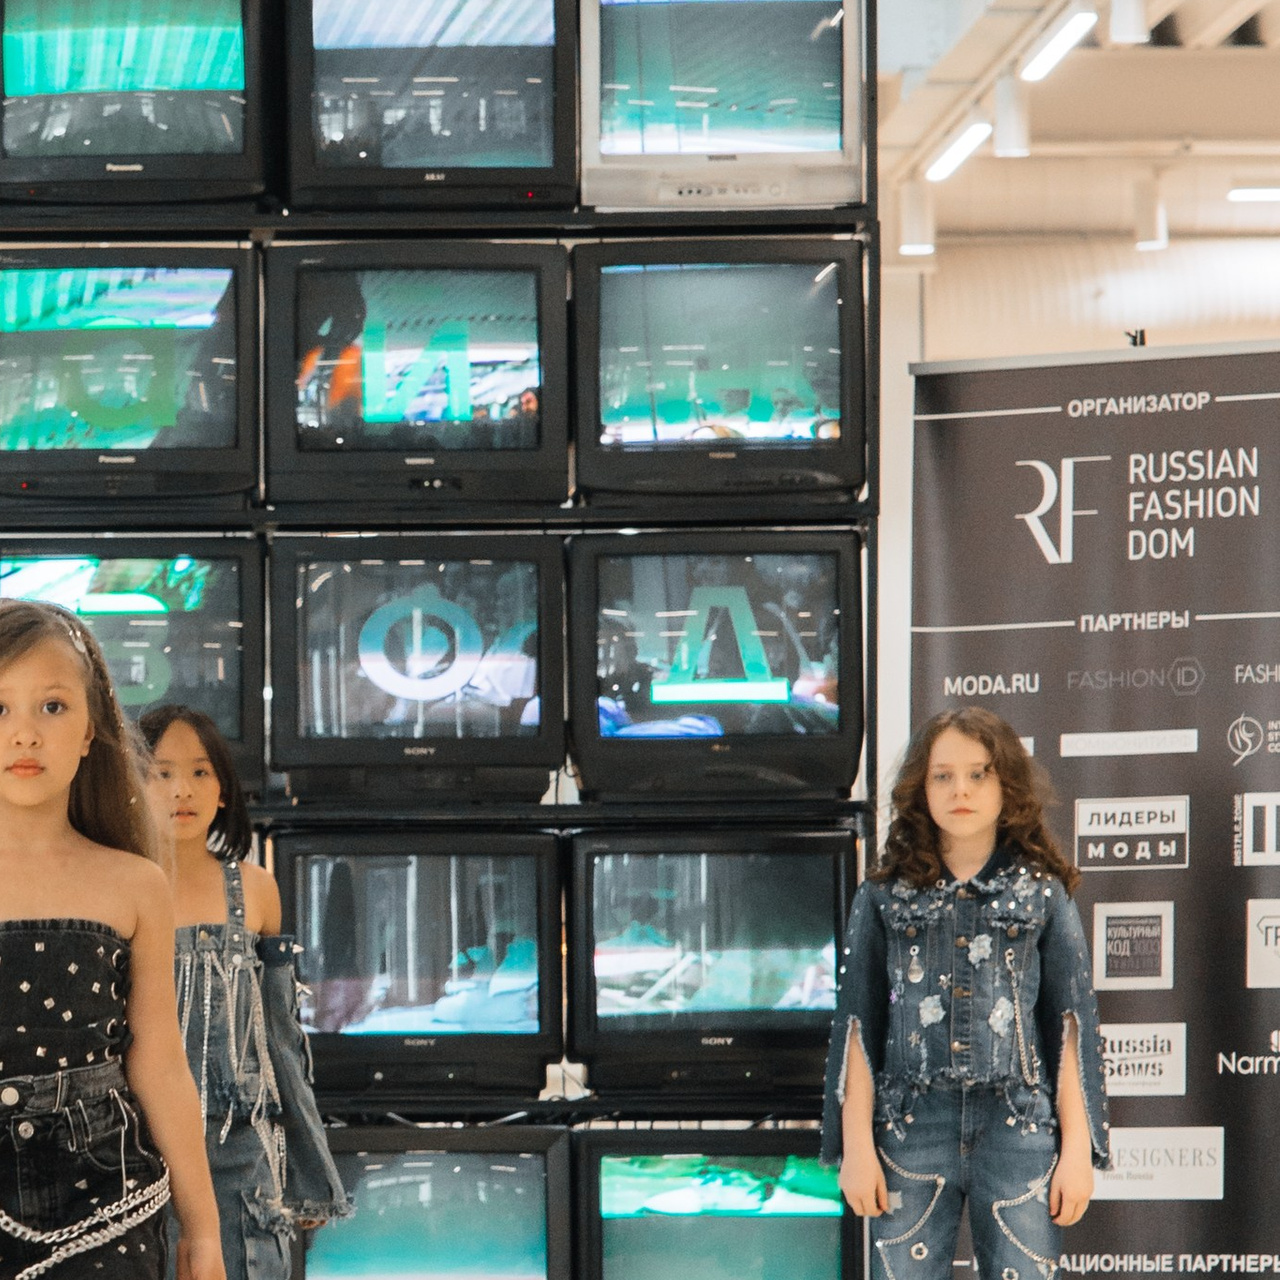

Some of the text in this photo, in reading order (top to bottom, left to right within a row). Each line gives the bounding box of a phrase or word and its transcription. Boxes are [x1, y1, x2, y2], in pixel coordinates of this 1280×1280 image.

[1067, 391, 1211, 418] ОРГАНИЗАТОР
[1128, 446, 1258, 484] RUSSIAN
[1128, 485, 1260, 522] FASHION
[1127, 527, 1195, 561] DOM
[1080, 610, 1190, 632] ПАРТНЕРЫ
[944, 673, 1040, 697] MODA.RU
[1067, 666, 1199, 691] FASHION ID
[403, 746, 436, 755] SONY
[1088, 810, 1176, 828] ЛИДЕРЫ
[1087, 840, 1177, 860] МОДЫ
[1107, 939, 1130, 958] КОД
[701, 1036, 734, 1046] SONY
[1111, 1147, 1218, 1167] ESIGNERS
